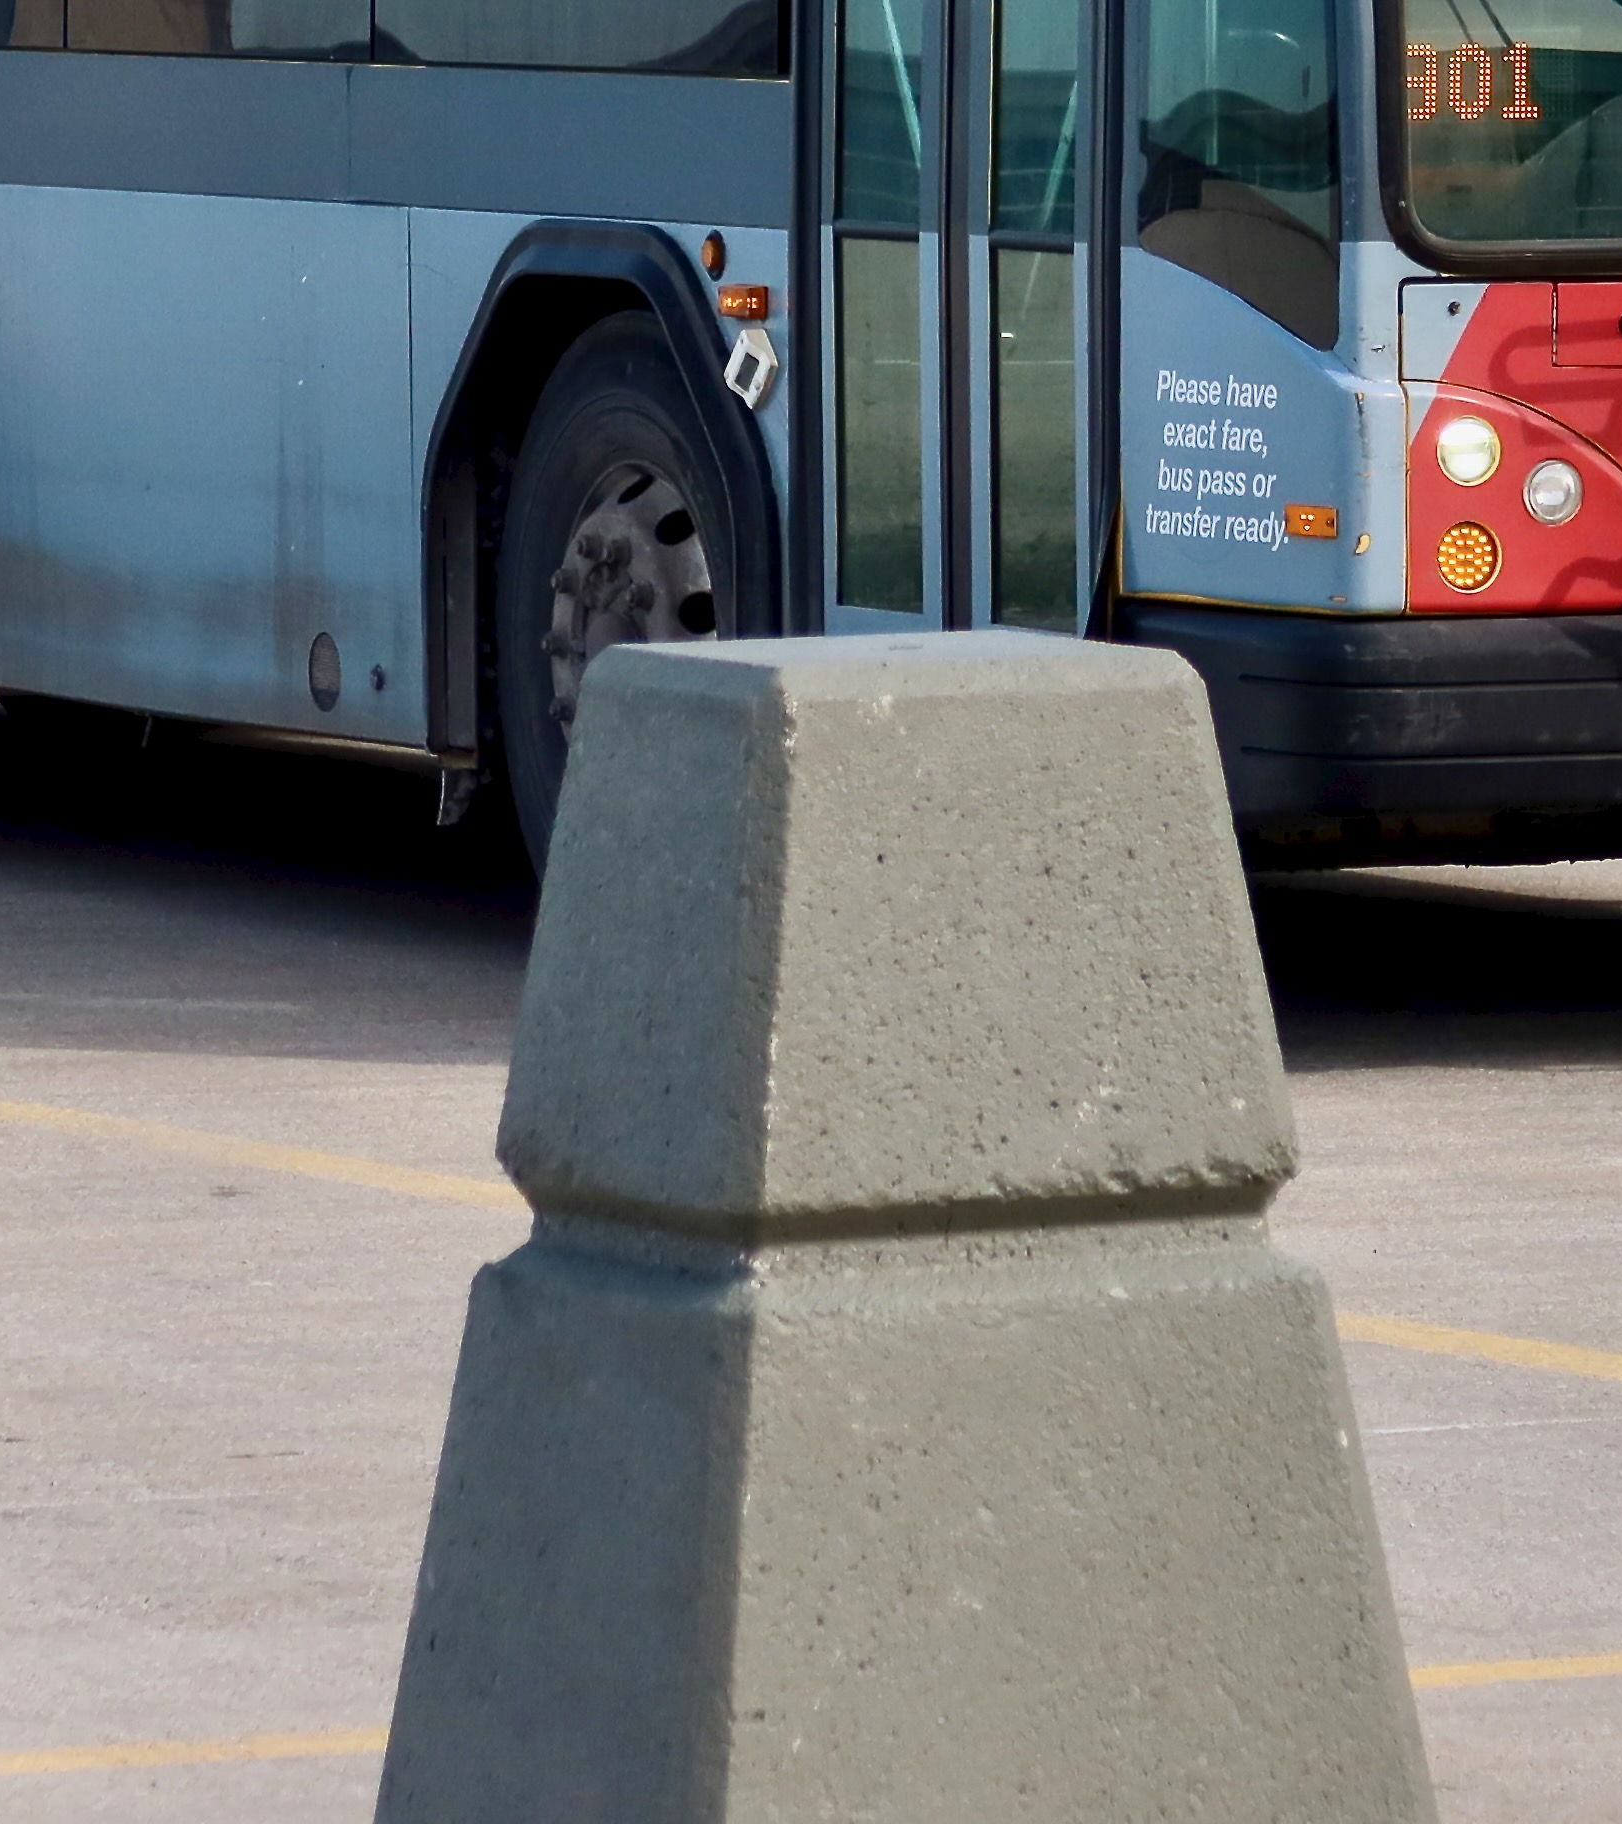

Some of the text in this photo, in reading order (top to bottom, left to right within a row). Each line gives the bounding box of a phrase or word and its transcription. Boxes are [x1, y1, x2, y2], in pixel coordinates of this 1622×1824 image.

[1156, 369, 1278, 410] Please have
[1163, 418, 1268, 459] exact fare,
[1157, 458, 1277, 501] bus pass or
[1145, 503, 1289, 552] transfer ready.
